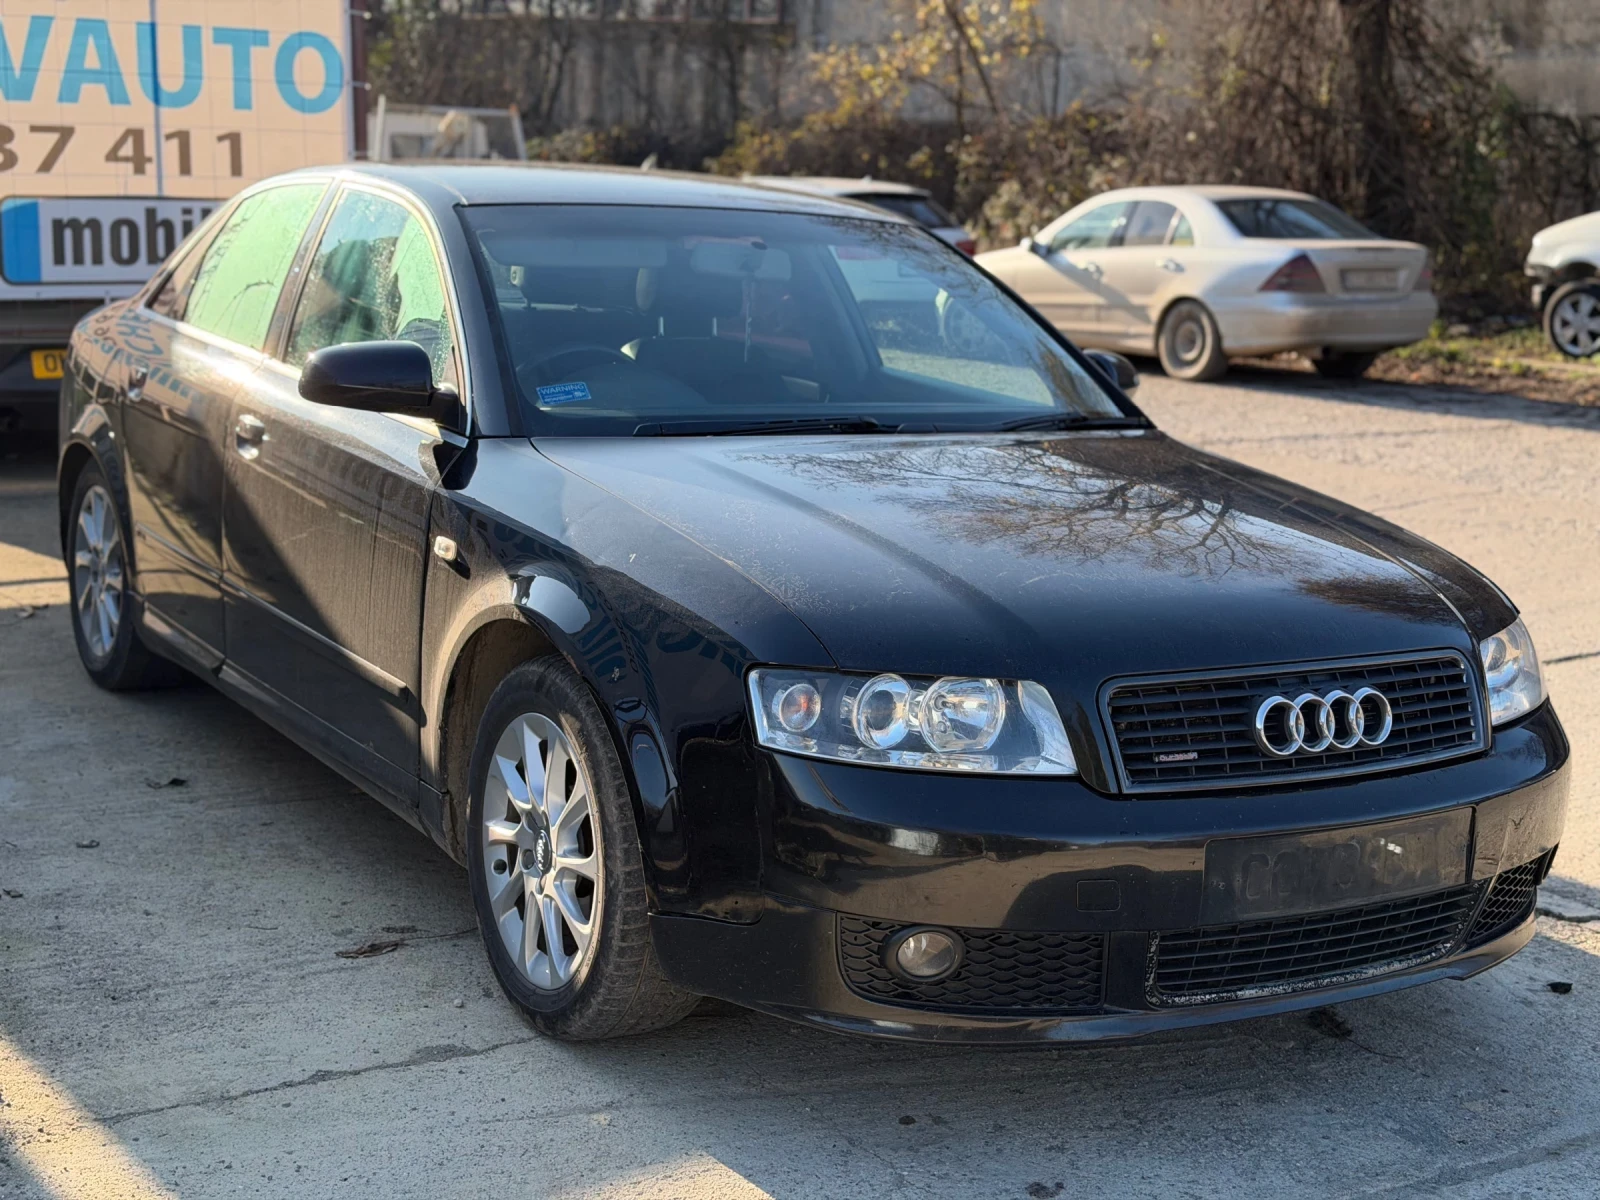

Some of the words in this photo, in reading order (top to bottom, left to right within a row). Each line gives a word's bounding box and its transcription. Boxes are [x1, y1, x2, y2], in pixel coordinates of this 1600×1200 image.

[104, 127, 243, 177] 411
[52, 207, 212, 266] mobi
[542, 384, 584, 394] WARNING
